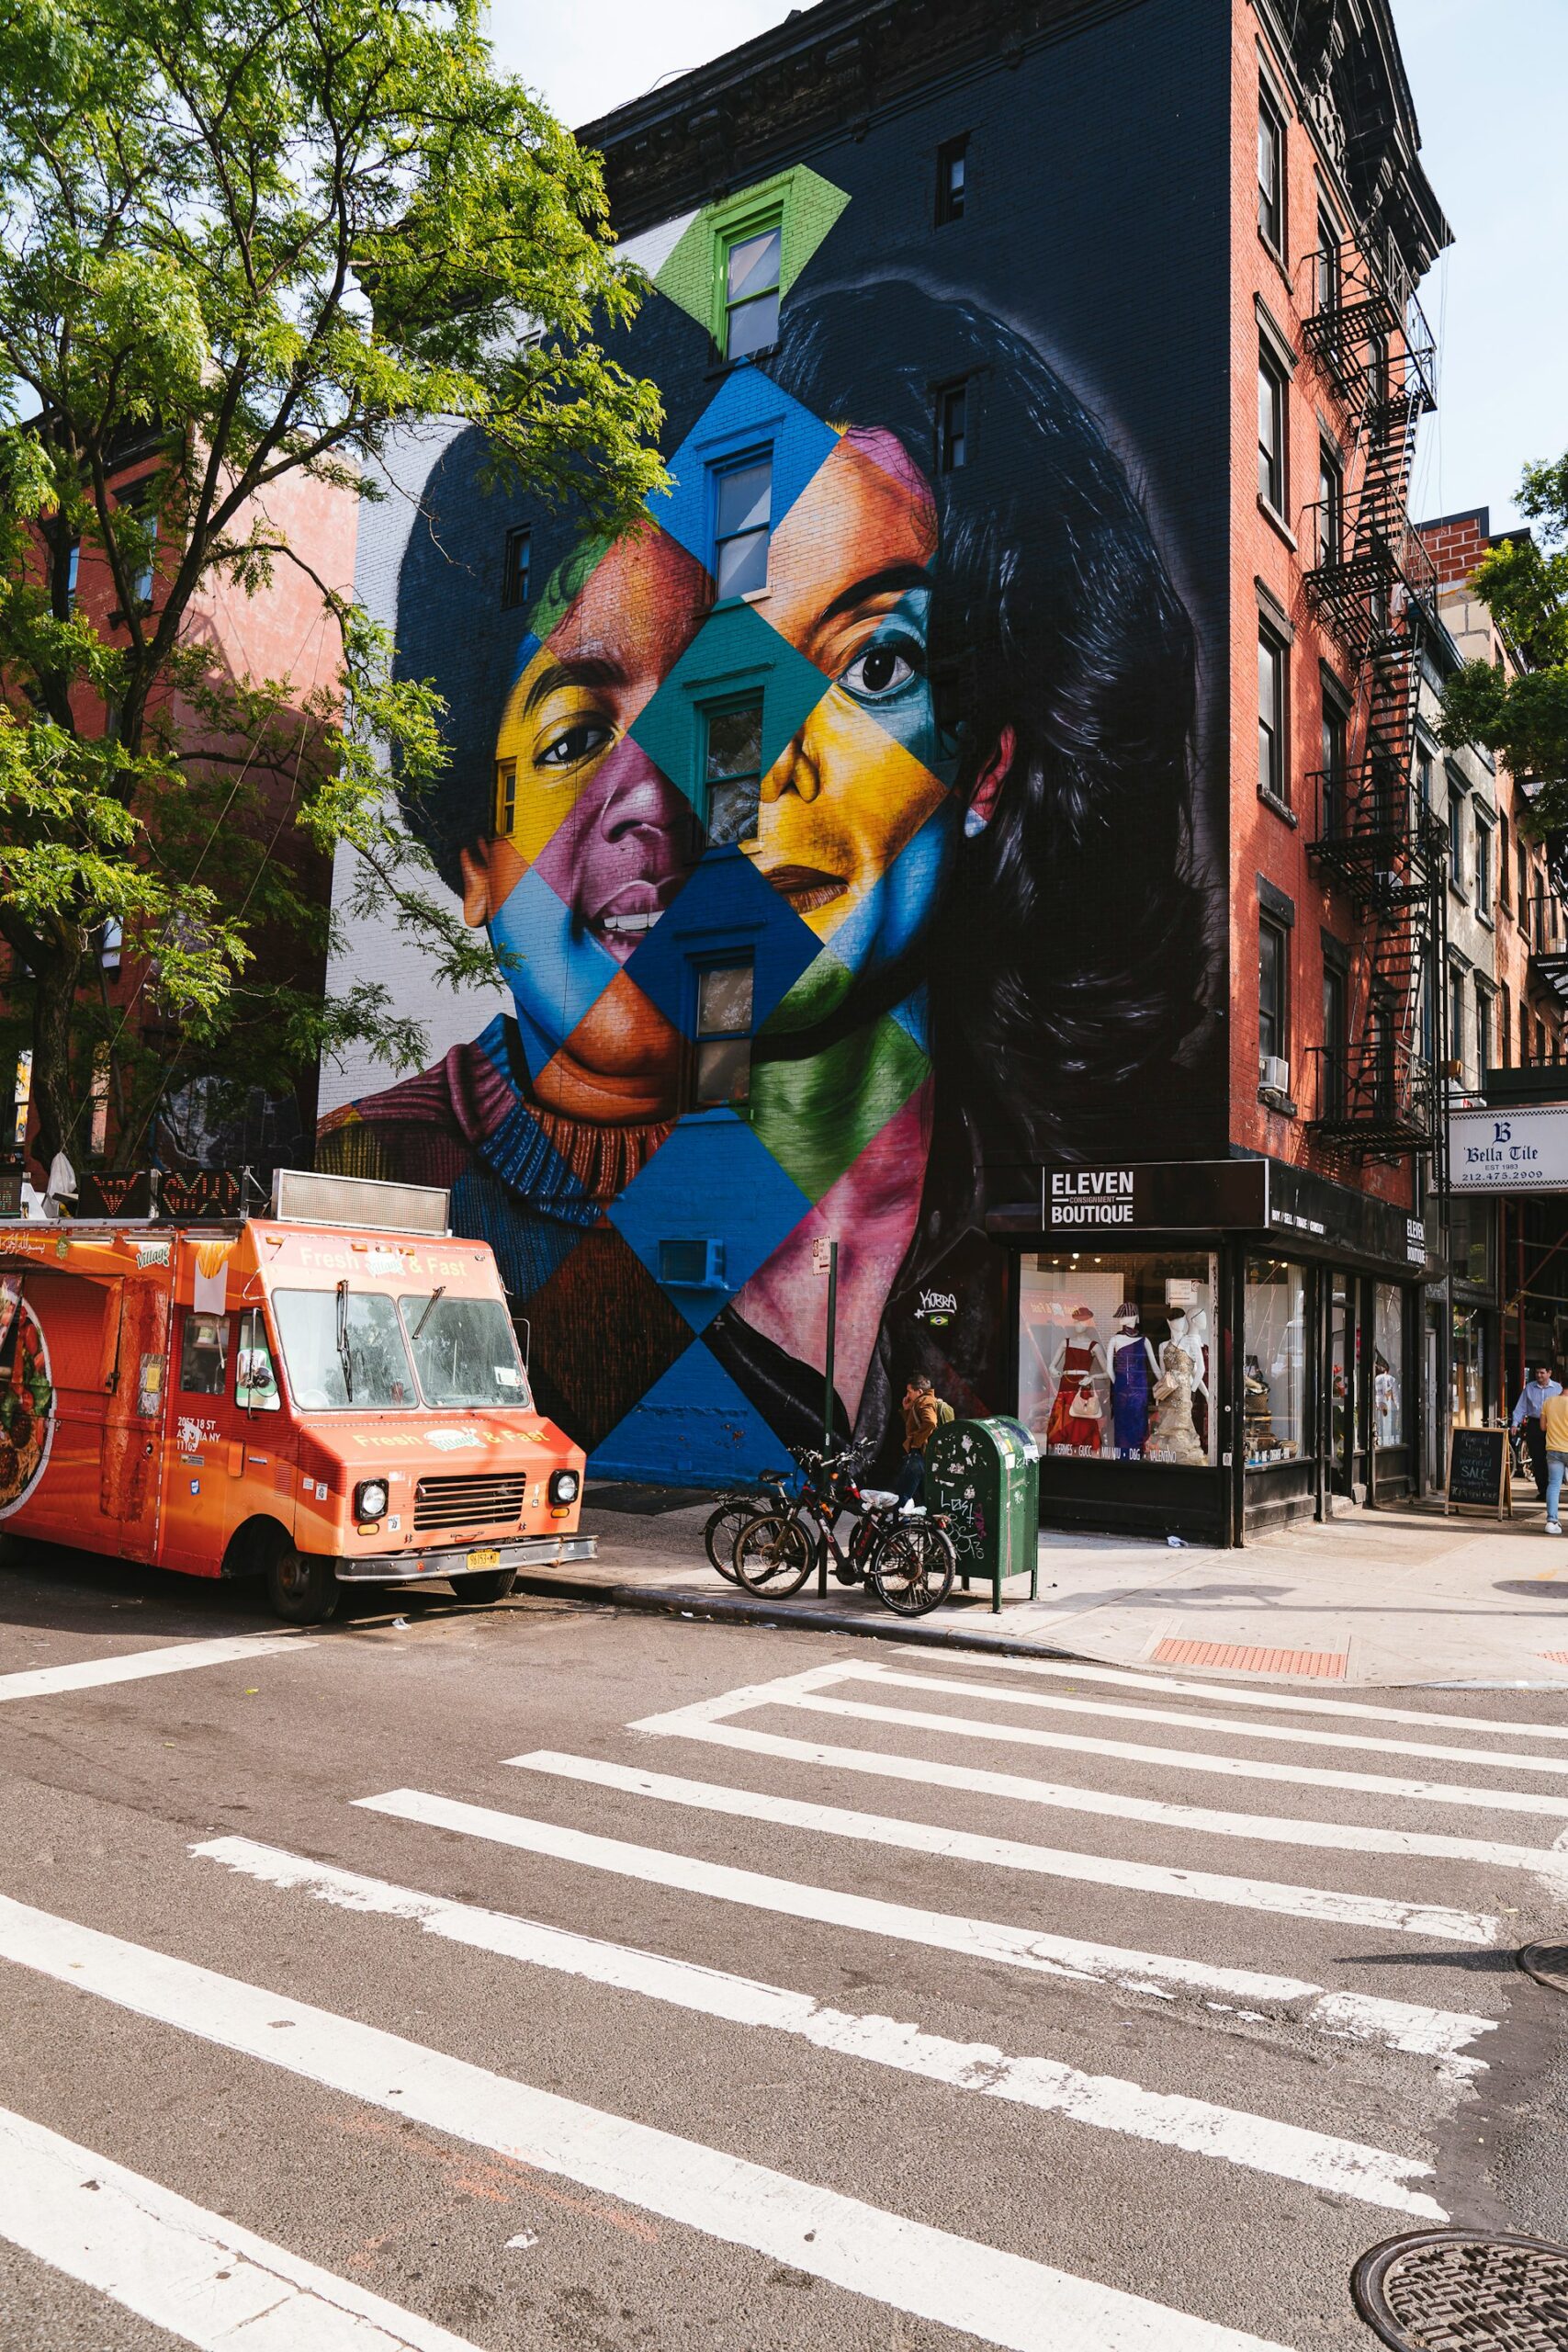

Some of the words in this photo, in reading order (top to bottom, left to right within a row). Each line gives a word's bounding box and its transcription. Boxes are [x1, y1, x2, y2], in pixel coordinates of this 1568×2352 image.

[1464, 1147, 1503, 1165] Bella
[1509, 1145, 1539, 1160] Tile
[1052, 1171, 1134, 1194] ELEVEN
[1462, 1170, 1542, 1182] 212.475.2909
[1052, 1204, 1134, 1224] BOUTIQUE
[1407, 1218, 1424, 1241] ELEVEN
[137, 1246, 170, 1268] Village
[299, 1247, 359, 1270] Fresh
[409, 1256, 423, 1273] &
[427, 1257, 467, 1276] Fast
[919, 1288, 957, 1311] KOBRA
[197, 1419, 205, 1430] 18
[207, 1419, 216, 1430] ST
[209, 1432, 220, 1443] NY
[352, 1432, 423, 1447] Fresh
[483, 1431, 502, 1443] &
[501, 1429, 550, 1443] Fast
[1055, 1443, 1073, 1455] HERMES
[1129, 1448, 1141, 1460] D&G
[1149, 1450, 1177, 1463] VALENTINO
[1461, 1465, 1489, 1480] SALE
